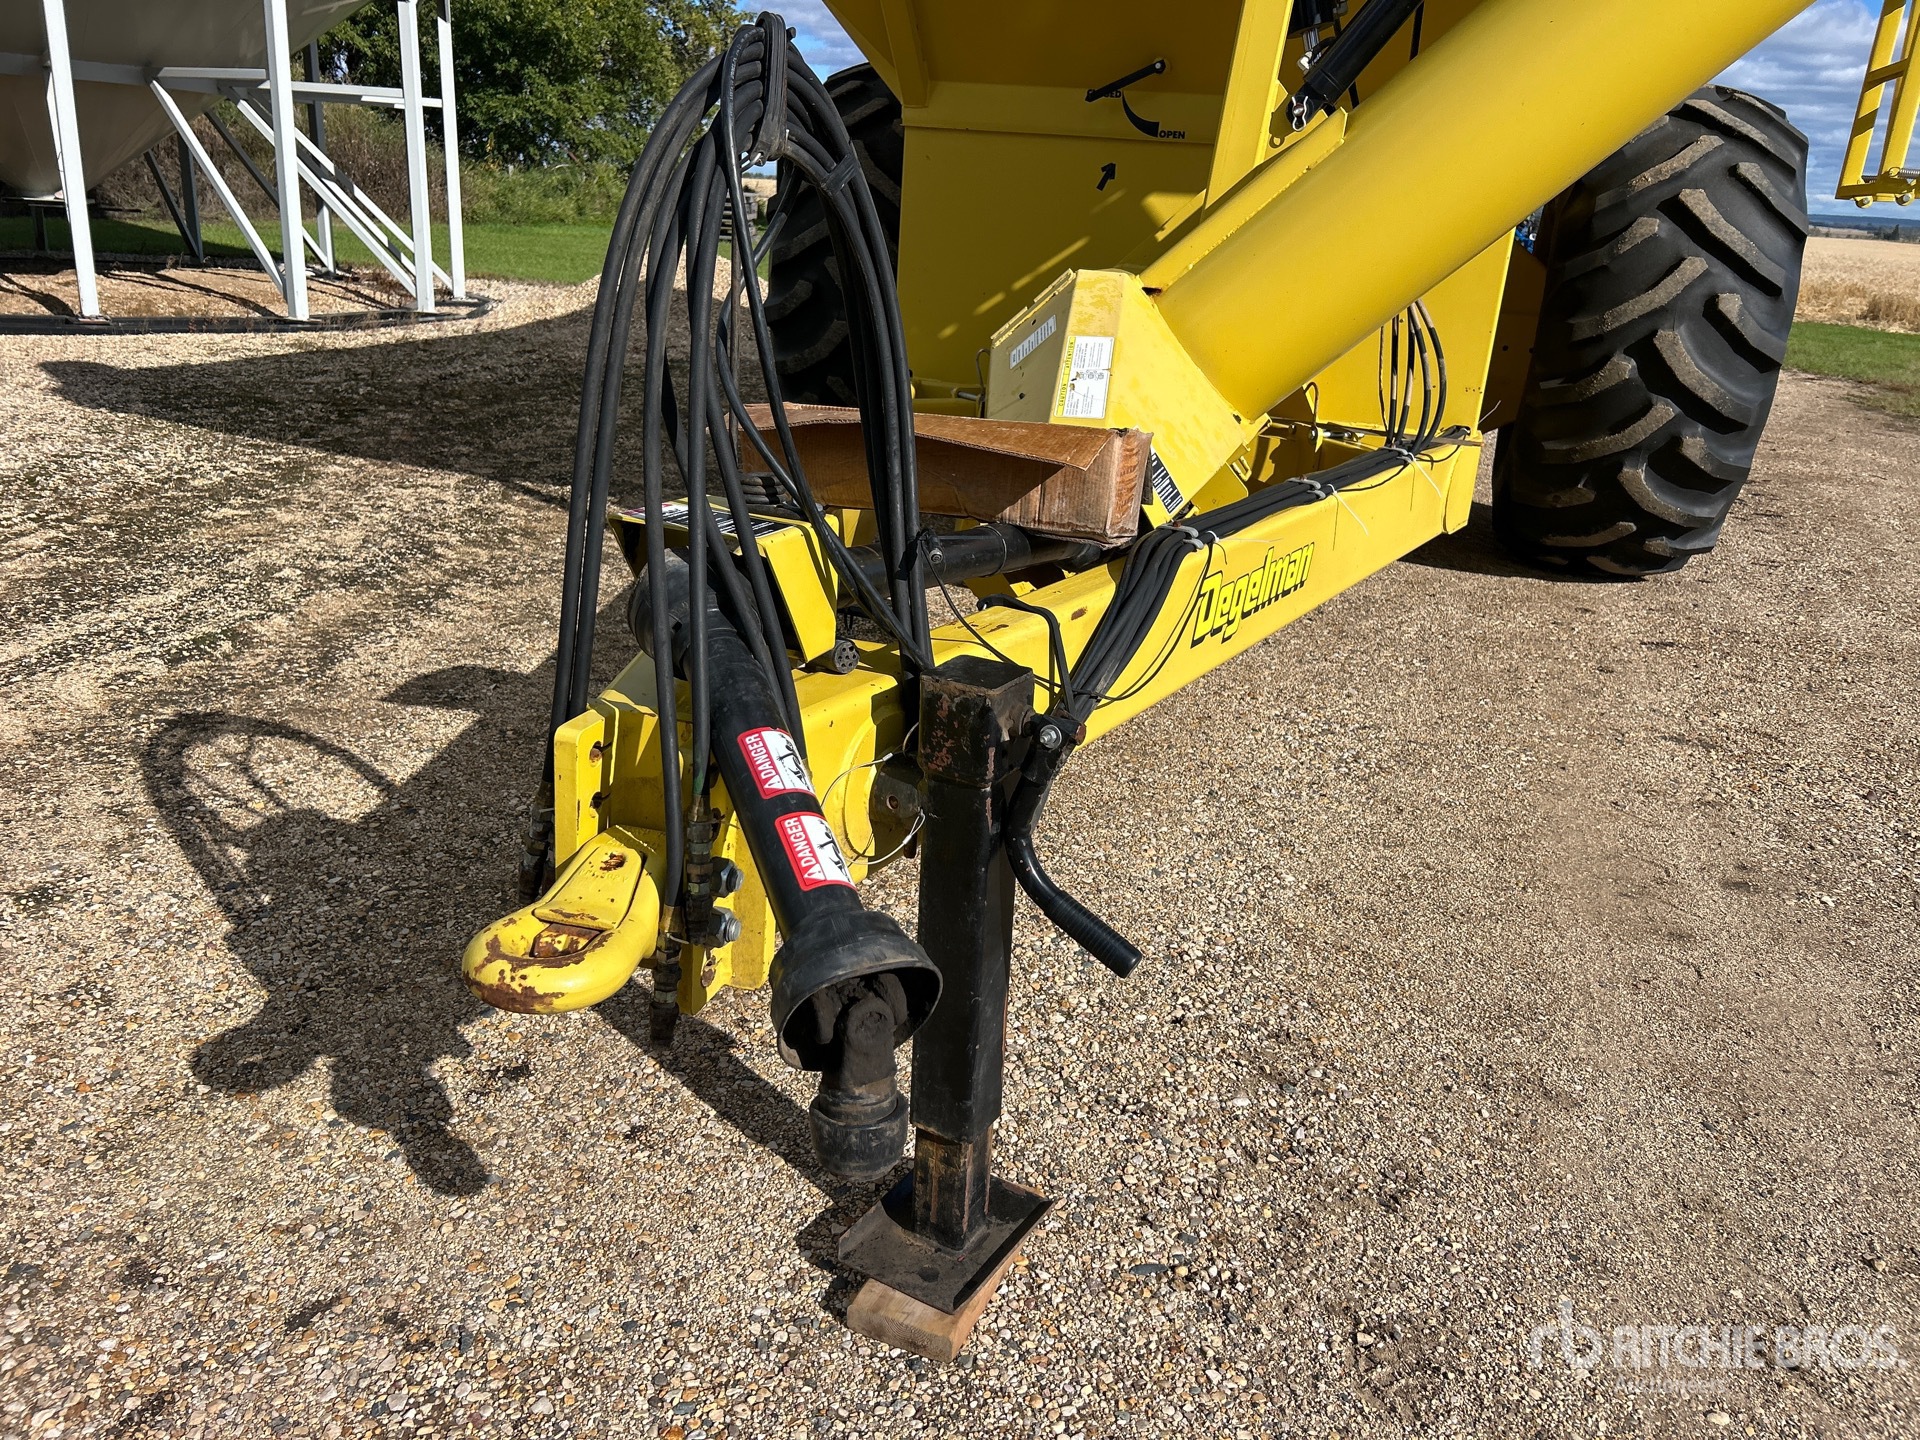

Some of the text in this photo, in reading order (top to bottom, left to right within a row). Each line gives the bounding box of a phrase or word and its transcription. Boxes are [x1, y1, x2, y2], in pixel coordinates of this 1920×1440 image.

[1159, 130, 1185, 139] OPEN
[1059, 383, 1067, 407] CAUTION
[1190, 541, 1315, 649] Degelman
[745, 733, 776, 780] DANGER
[784, 817, 816, 868] DANGER
